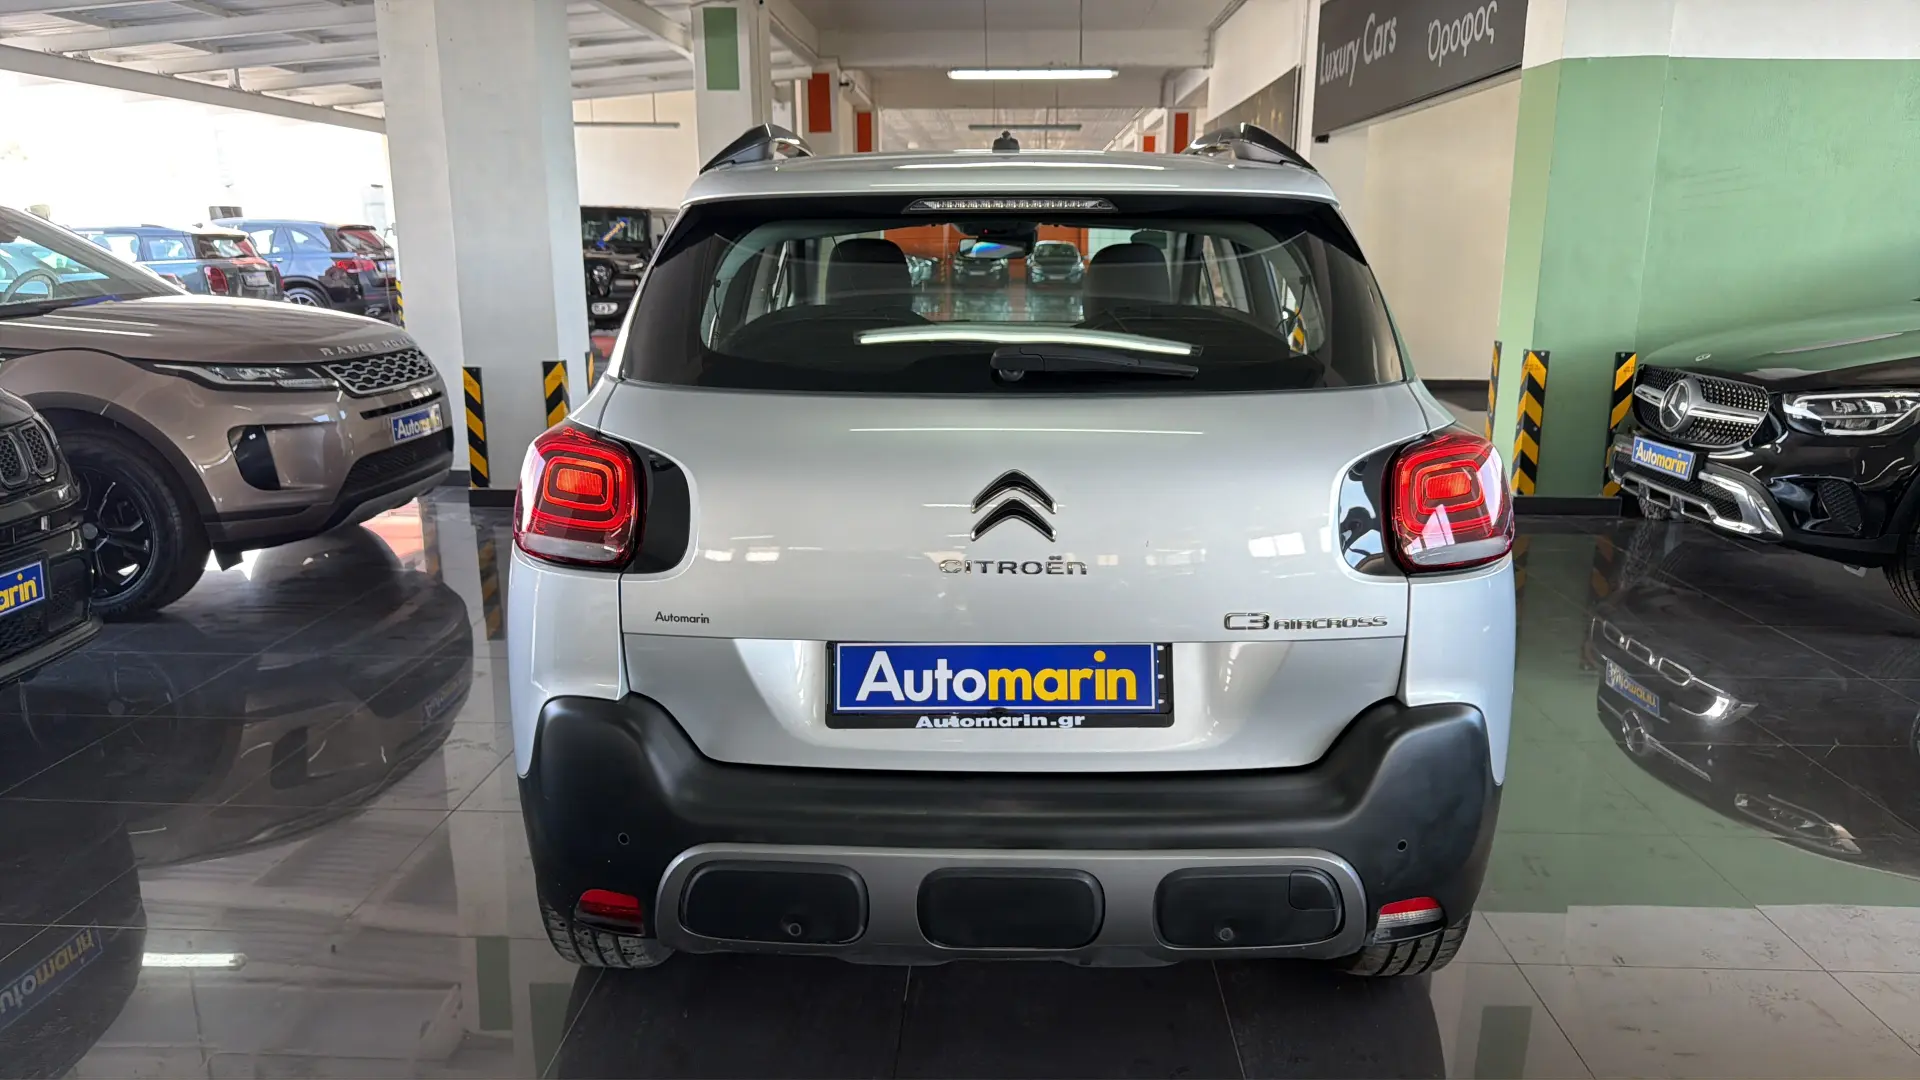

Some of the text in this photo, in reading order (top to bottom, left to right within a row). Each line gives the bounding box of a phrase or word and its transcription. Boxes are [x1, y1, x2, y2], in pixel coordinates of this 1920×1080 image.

[1427, 0, 1497, 67] Όροφος
[1320, 12, 1397, 87] Luxury Cars
[319, 342, 378, 357] RANGE
[1635, 441, 1688, 474] Automarin
[655, 611, 710, 624] Automarin
[1223, 612, 1388, 630] C3 AIRCROSS
[855, 649, 1137, 702] Automarin
[915, 713, 1085, 729] Automarin.gr
